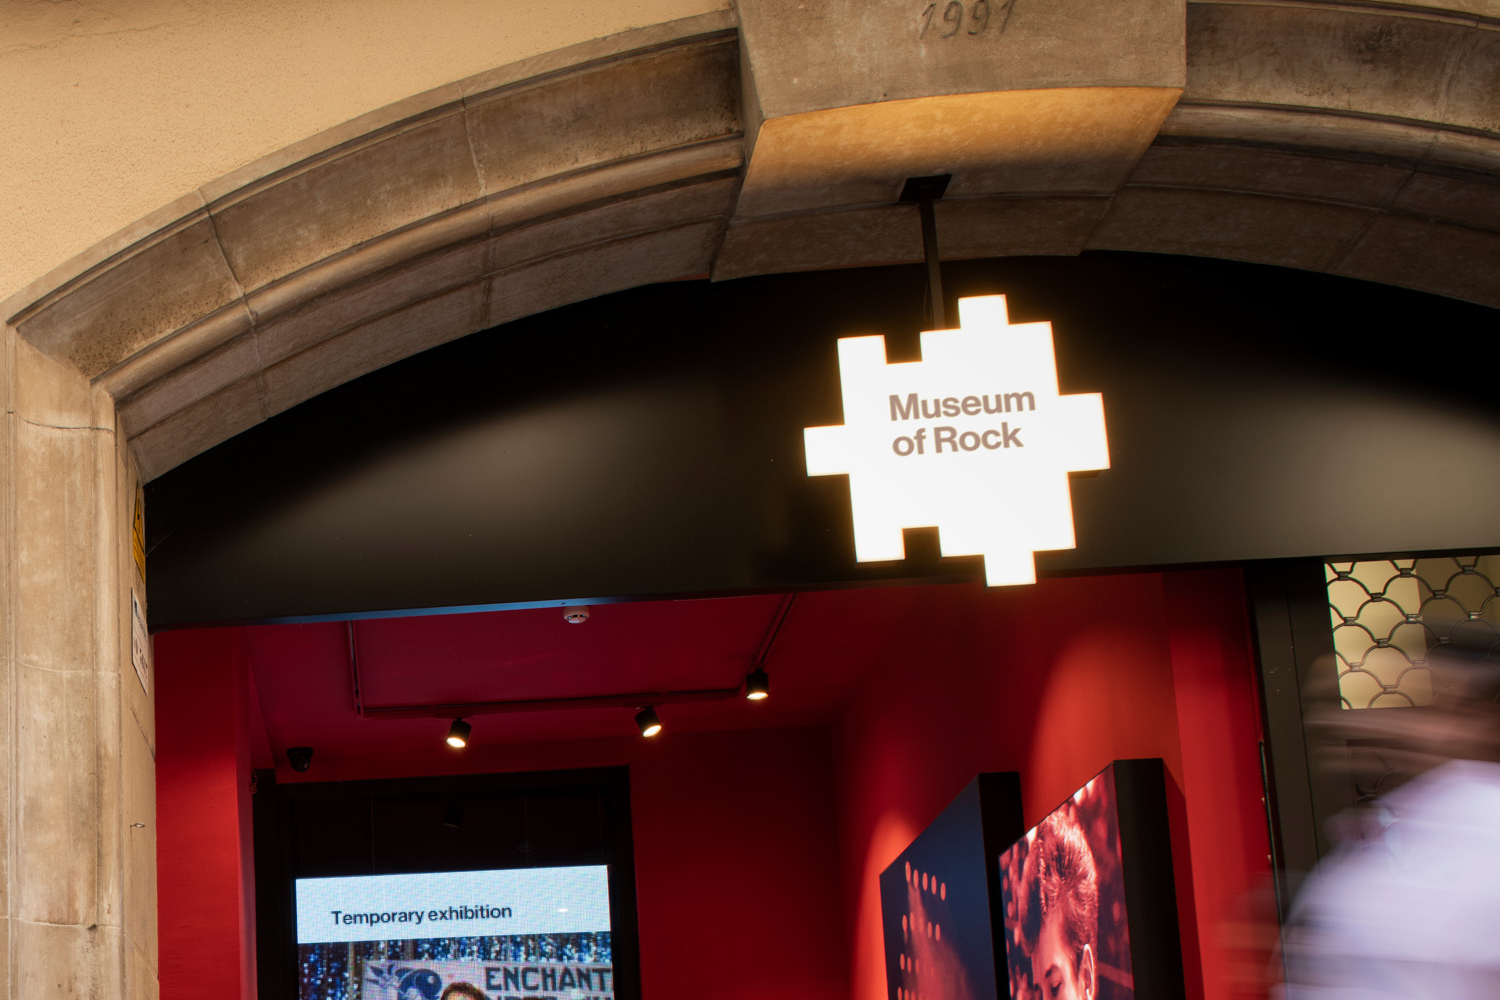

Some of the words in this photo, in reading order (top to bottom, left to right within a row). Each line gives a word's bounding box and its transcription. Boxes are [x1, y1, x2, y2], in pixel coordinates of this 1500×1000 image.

[889, 391, 1036, 421] Museum
[891, 427, 927, 456] of
[934, 422, 1024, 453] Rock
[331, 910, 424, 927] Temporary
[428, 904, 512, 921] exhibition
[485, 966, 613, 991] ENCHANT
